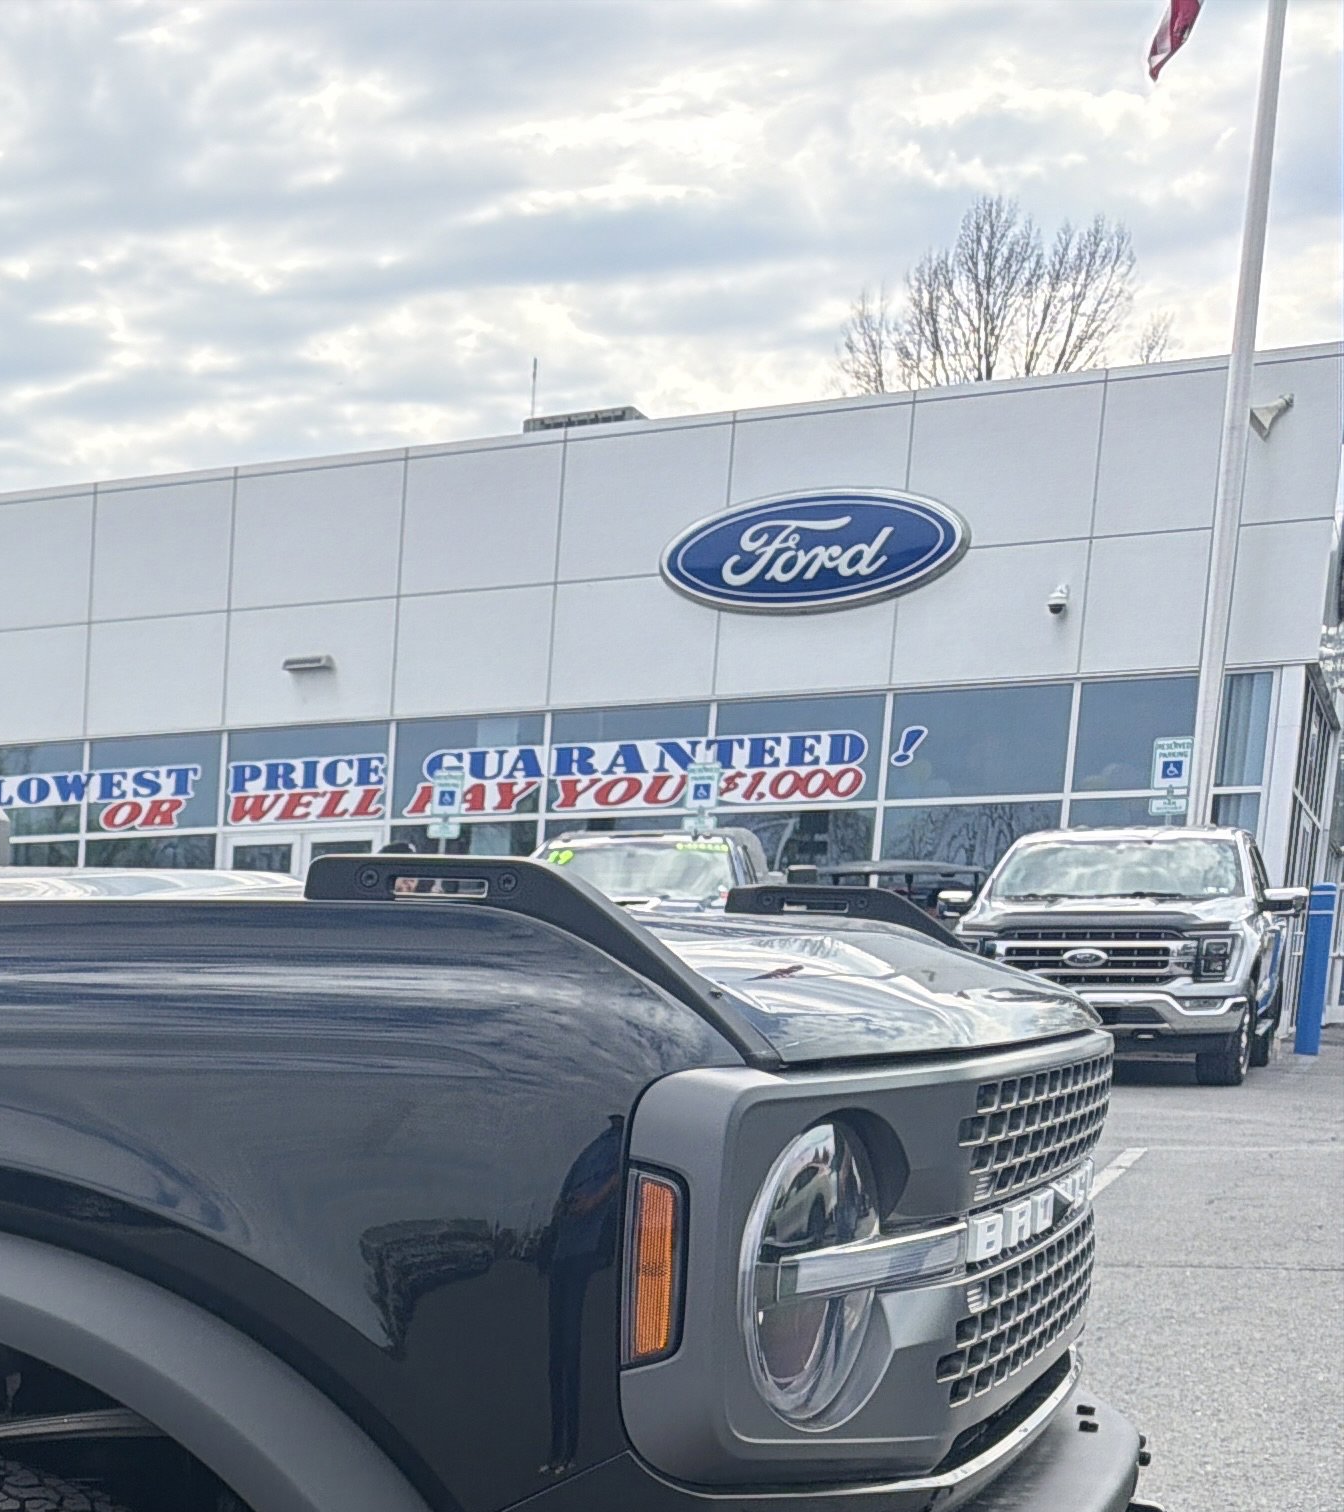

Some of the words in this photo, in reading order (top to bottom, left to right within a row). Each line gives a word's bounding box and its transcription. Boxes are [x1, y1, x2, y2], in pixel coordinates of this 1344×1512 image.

[721, 515, 895, 587] Ford
[229, 755, 386, 794] PRICE
[425, 732, 866, 781] GUARANTEED
[100, 797, 184, 831] OR
[557, 773, 688, 810] YOU
[718, 766, 863, 802] $1,000
